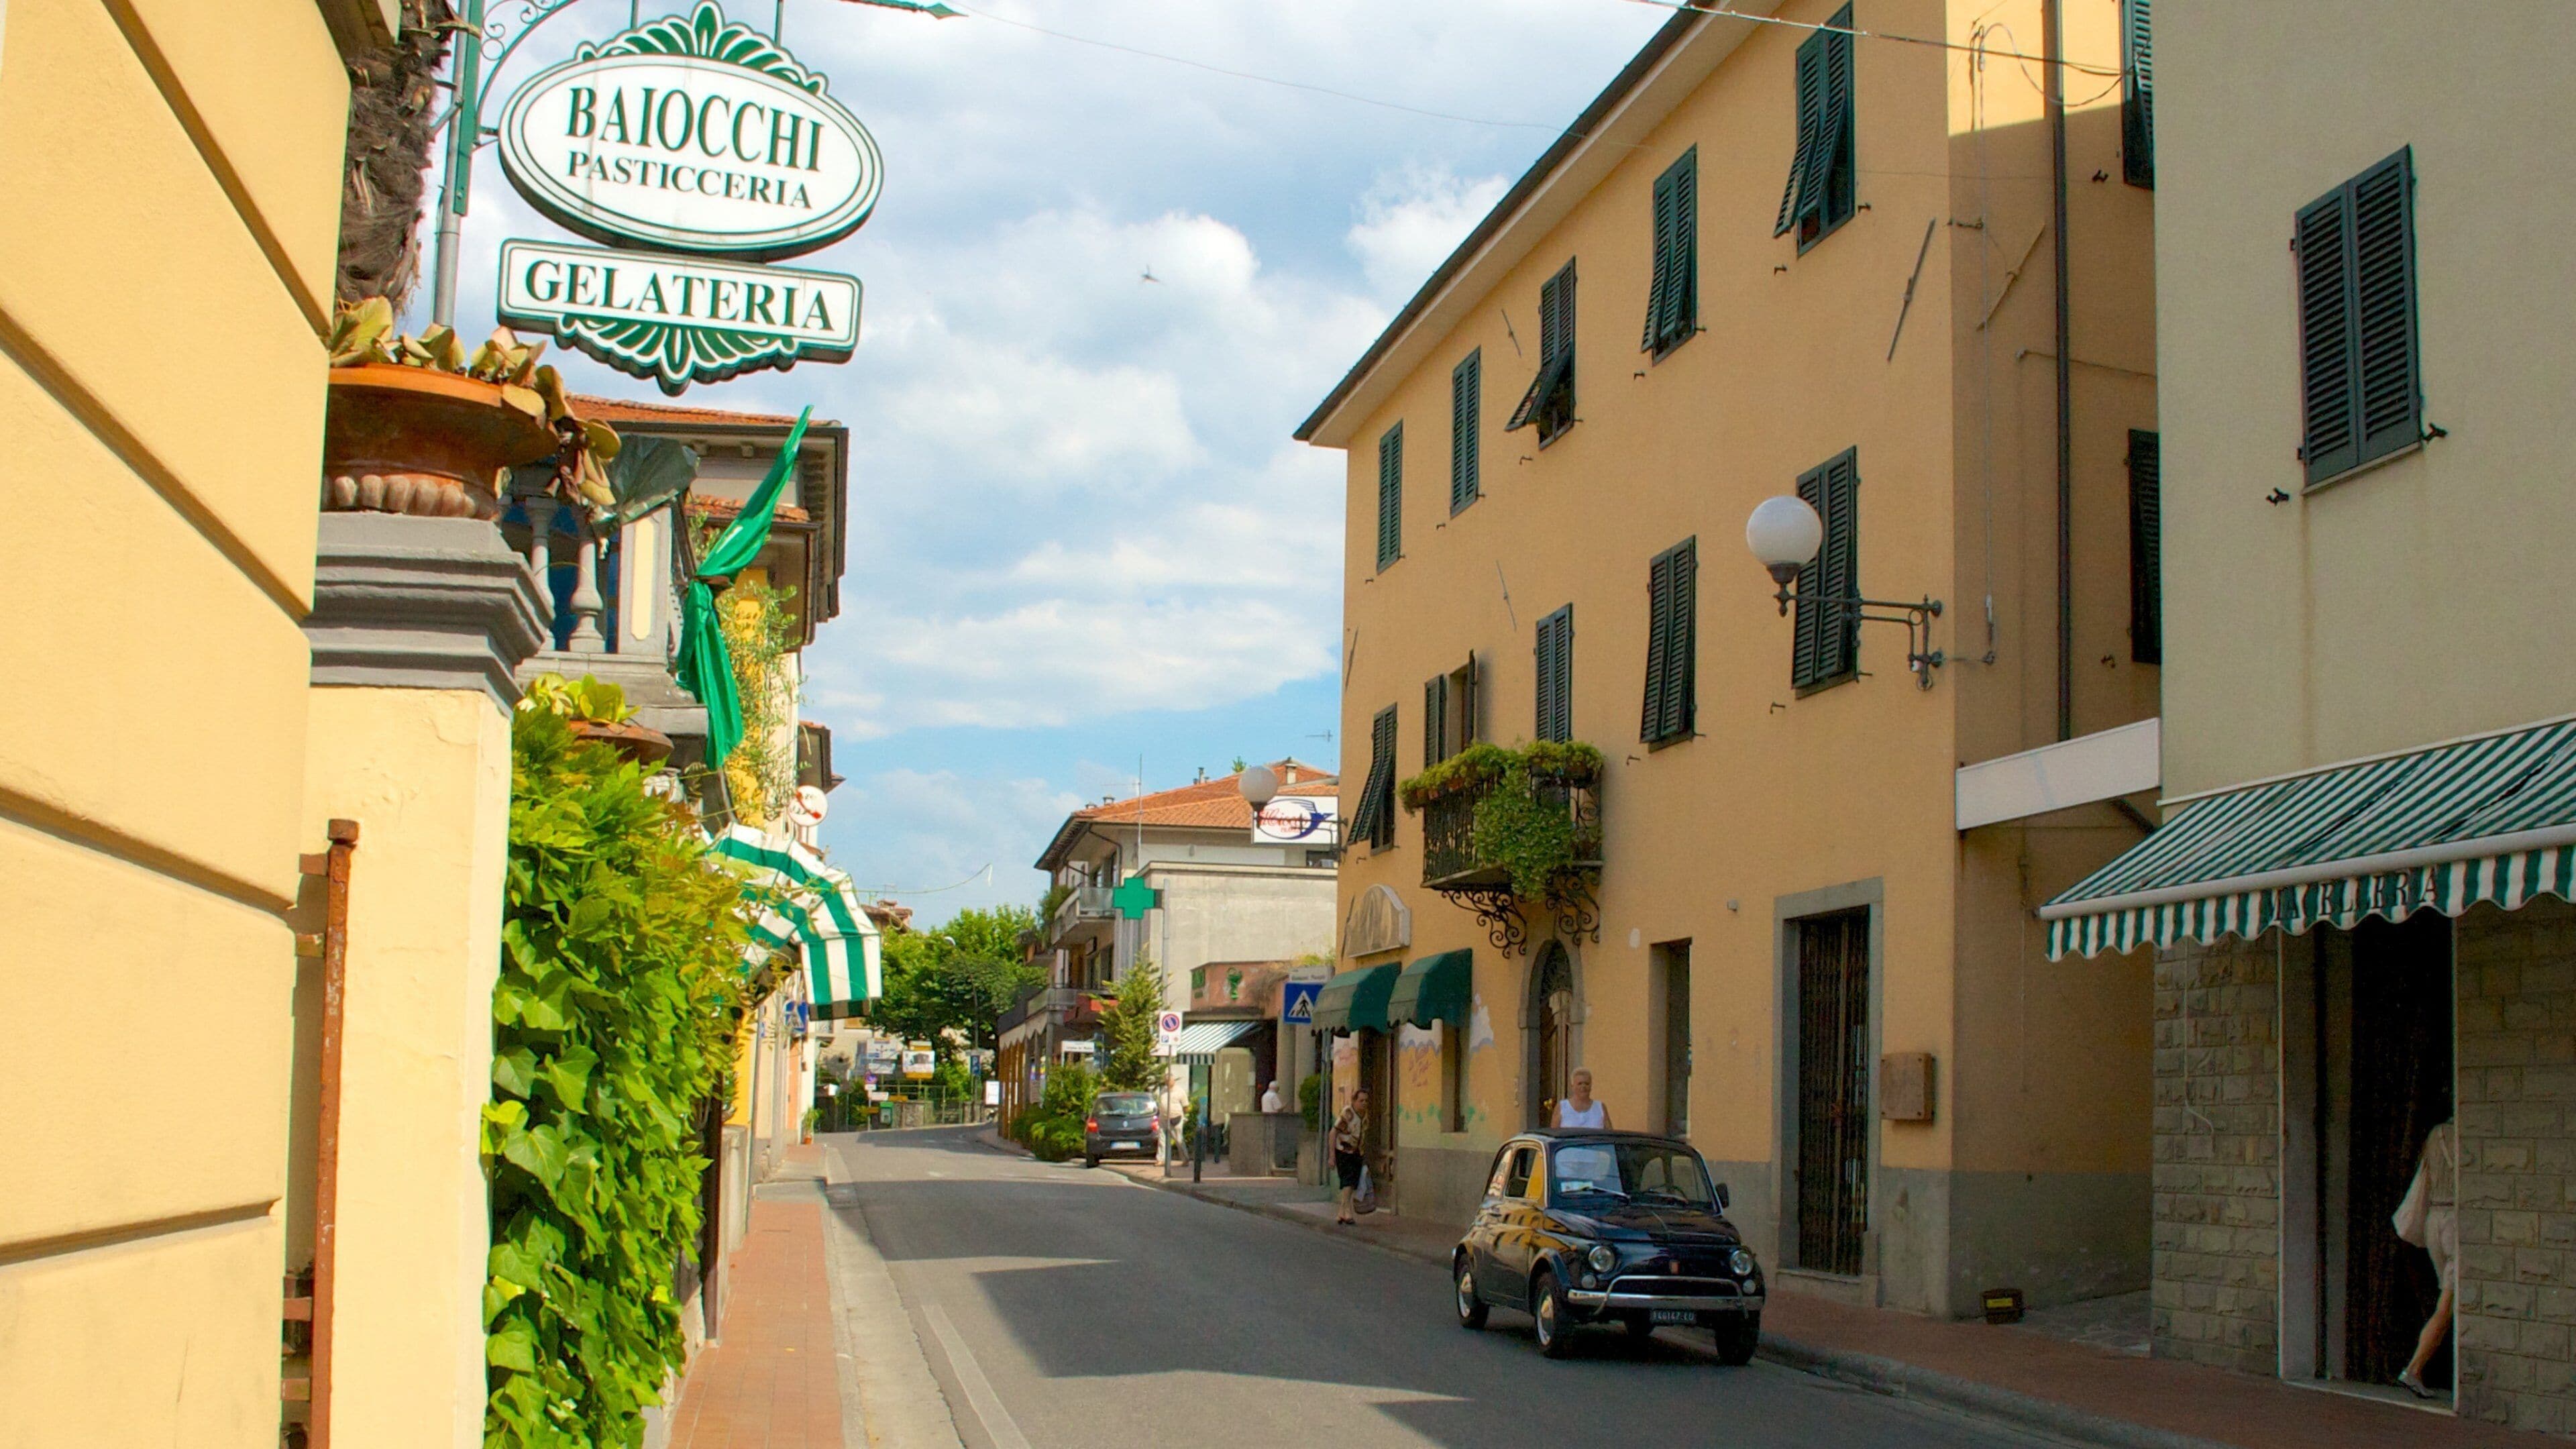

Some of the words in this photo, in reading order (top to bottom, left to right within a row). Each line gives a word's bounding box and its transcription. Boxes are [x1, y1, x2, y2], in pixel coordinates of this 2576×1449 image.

[566, 87, 825, 172] BAIOCCHI
[566, 150, 813, 209] PASTICCERIA
[525, 259, 835, 331] GELATERIA
